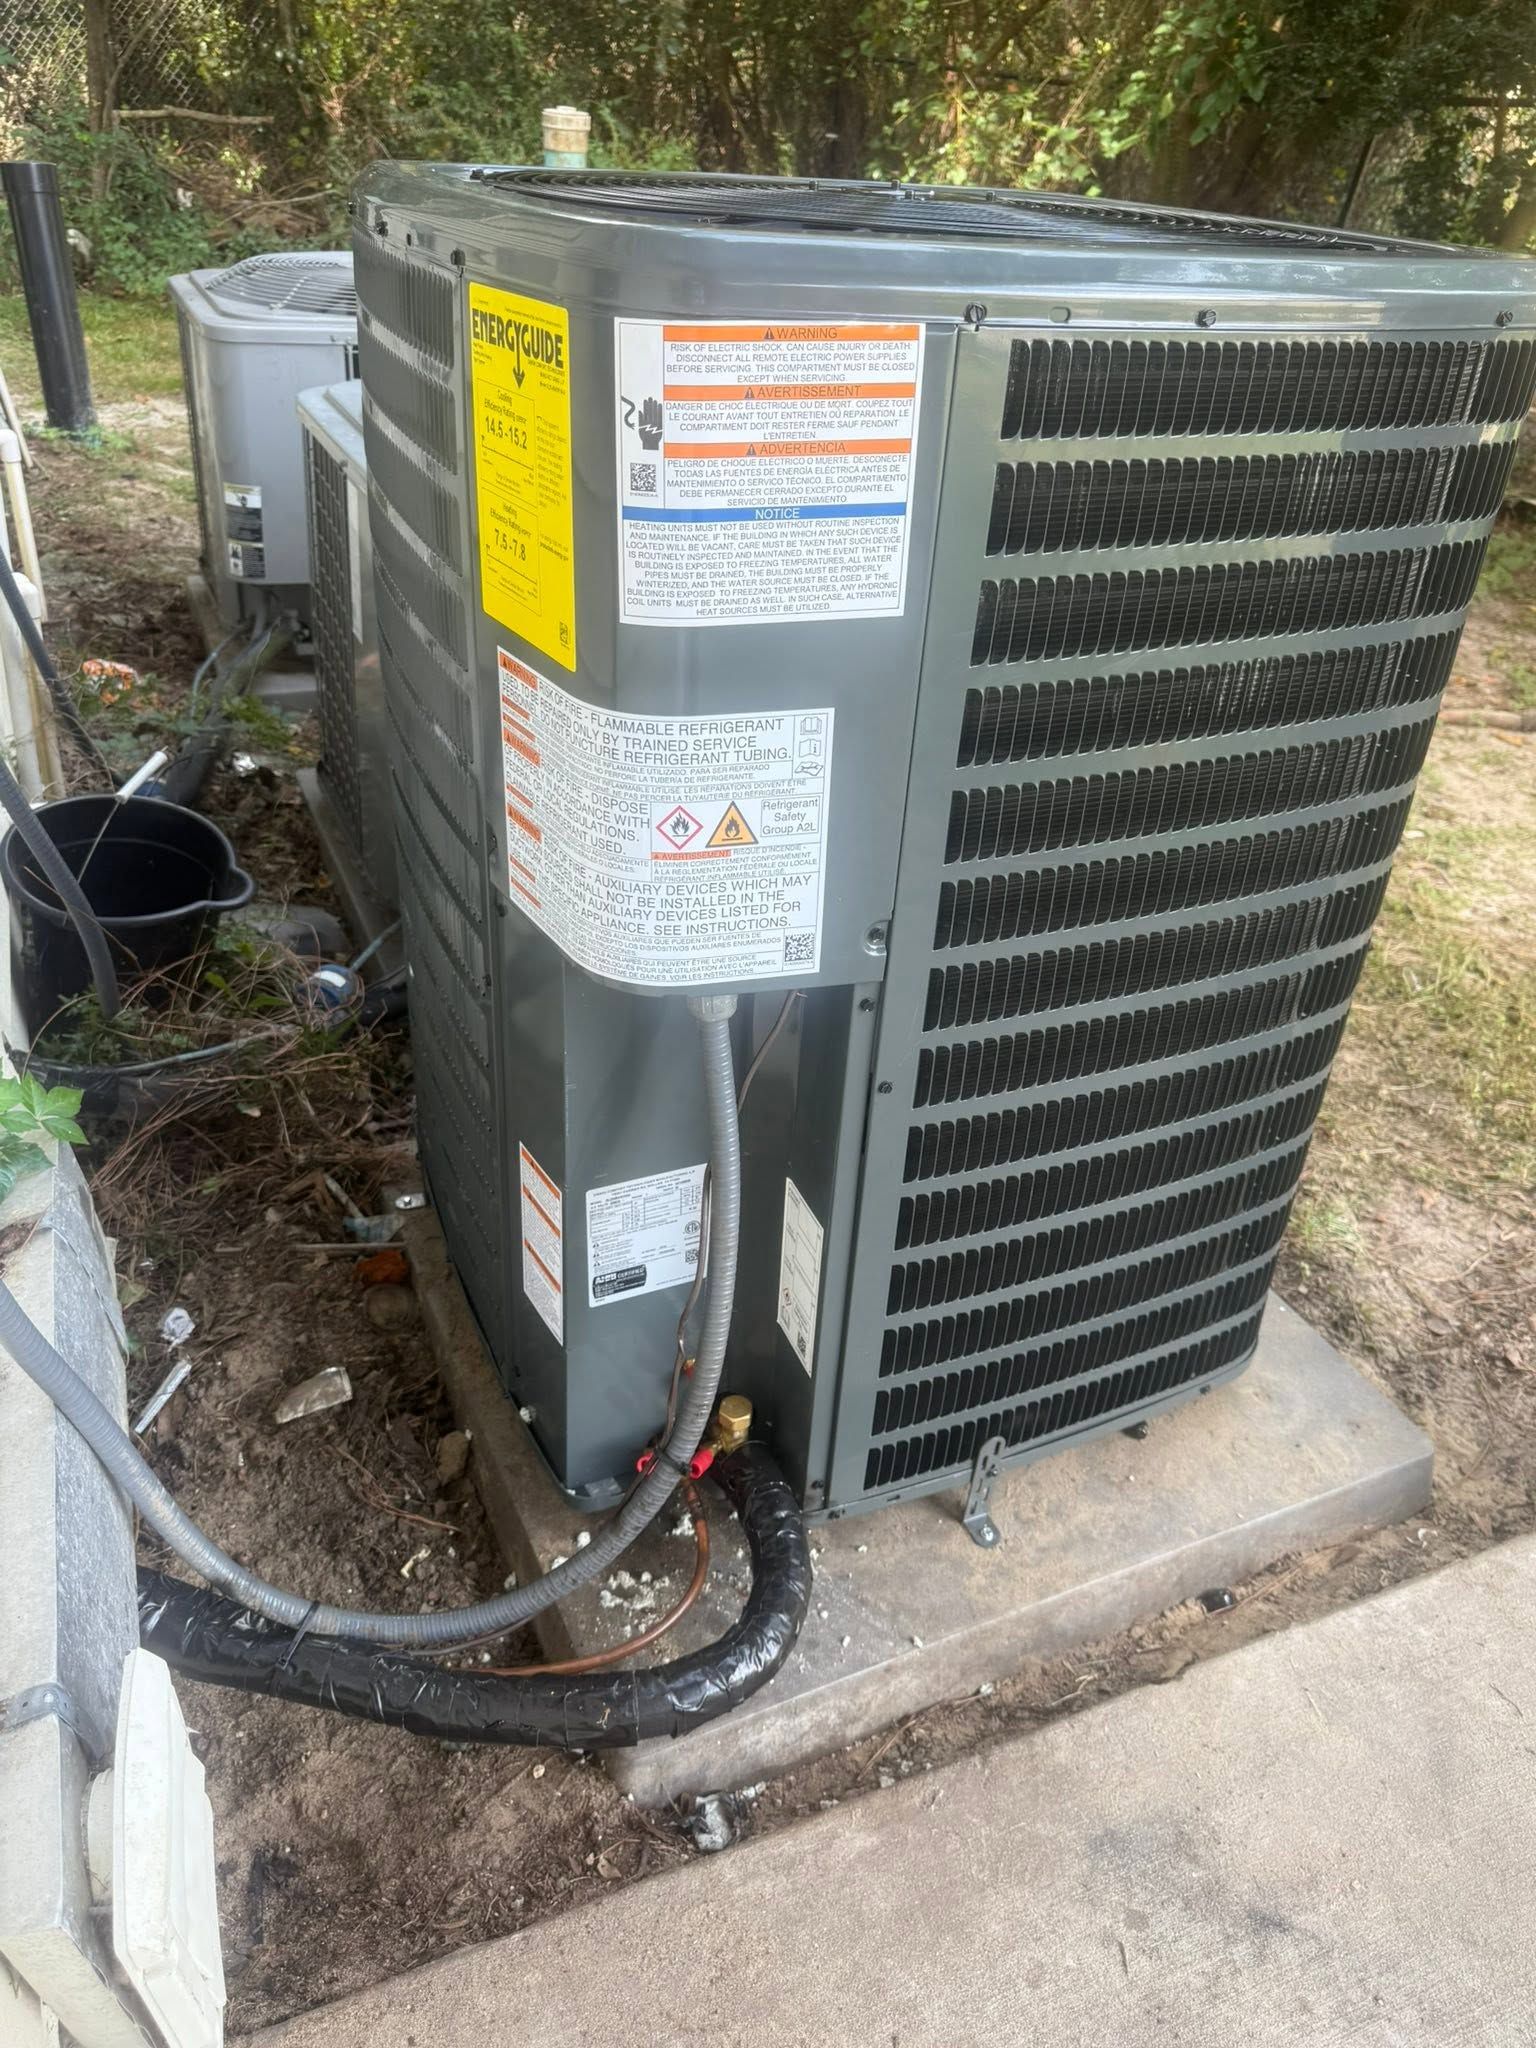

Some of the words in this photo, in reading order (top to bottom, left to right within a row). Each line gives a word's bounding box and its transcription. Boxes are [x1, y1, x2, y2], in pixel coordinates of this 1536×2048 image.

[472, 308, 564, 369] ENERGYGUIDE
[777, 327, 838, 339] WARNING
[671, 344, 691, 352] RISK
[694, 344, 705, 352] OF
[787, 343, 804, 351] CAN
[807, 343, 834, 351] CAUSE
[837, 343, 865, 351] INJURY
[676, 354, 732, 362] DISCONNECT
[736, 354, 750, 362] ALL
[753, 354, 788, 362] REMOTE
[791, 353, 831, 361] ELECTRIC
[834, 353, 864, 361] POWER
[666, 365, 702, 373] BEFORE
[757, 364, 774, 372] THIS
[777, 364, 840, 372] COMPARTMENT
[844, 363, 868, 371] MUST
[869, 363, 879, 371] BE
[882, 363, 914, 371] CLOSED
[738, 375, 770, 383] EXCEPT
[773, 374, 798, 382] WHEN
[758, 385, 861, 398] AVERTISSEMENT
[666, 403, 702, 411] DANGER
[705, 403, 716, 411] DE
[800, 401, 812, 409] OU
[856, 400, 889, 408] COUPEZ
[669, 413, 679, 421] LE
[682, 413, 724, 421] COURANT
[726, 412, 753, 420] AVANT
[756, 412, 778, 420] TOUT
[781, 411, 826, 419] ENTRETIEN
[680, 422, 747, 431] COMPARTIMENT
[750, 422, 769, 431] DOIT
[772, 421, 804, 430] RESTER
[837, 420, 859, 428] SAUF
[861, 419, 898, 427] PENDANT
[760, 442, 846, 455] ADVERTENCIA
[668, 460, 705, 468] PELIGRO
[707, 459, 718, 467] DE
[721, 459, 756, 467] CHOQUE
[853, 455, 907, 463] DESCONECTE
[675, 470, 703, 478] TODAS
[723, 468, 760, 477] FUENTES
[763, 468, 774, 476] DE
[862, 465, 887, 473] ANTES
[666, 479, 736, 488] MANTENIMIENTO
[680, 489, 702, 497] DEBE
[705, 488, 761, 497] PERMANECER
[806, 485, 843, 494] EXCEPTO
[845, 484, 881, 492] DURANTE
[755, 508, 800, 519] NOTICE
[629, 522, 665, 532] HEATING
[668, 523, 692, 532] UNITS
[695, 524, 718, 532] MUST
[720, 523, 736, 531] NOT
[753, 522, 774, 530] USED
[777, 521, 813, 529] WITHOUT
[816, 519, 849, 528] ROUTINE
[852, 518, 899, 526] INSPECTION
[626, 542, 664, 551] LOCATED
[667, 543, 686, 551] WILL
[689, 543, 699, 551] BE
[787, 540, 797, 548] BE
[800, 539, 825, 547] TAKEN
[828, 538, 846, 546] THAT
[849, 537, 871, 545] SUCH
[873, 536, 901, 544] DEVICE
[638, 551, 685, 561] ROUTINELY
[687, 552, 733, 561] INSPECTED
[833, 547, 858, 555] EVENT
[635, 561, 673, 570] BUILDING
[686, 561, 724, 570] EXPOSED
[645, 571, 669, 579] PIPES
[671, 571, 693, 579] MUST
[696, 571, 706, 579] BE
[766, 568, 802, 577] BUILDING
[829, 566, 839, 574] BE
[841, 564, 882, 573] PROPERLY
[858, 582, 897, 590] HYDRONIC
[647, 599, 671, 607] UNITS
[676, 599, 698, 607] MUST
[713, 598, 748, 606] DRAINED
[798, 594, 819, 602] SUCH
[846, 591, 897, 600] ALTERNATIVE
[696, 608, 717, 616] HEAT
[720, 607, 757, 615] SOURCES
[760, 604, 781, 612] MUST
[565, 700, 582, 719] FIRE
[591, 712, 674, 736] FLAMMABLE
[679, 718, 784, 736] REFRIGERANT
[573, 721, 599, 740] ONLY
[603, 732, 619, 746] BY
[623, 736, 688, 752] TRAINED
[693, 736, 757, 751] SERVICE
[566, 729, 620, 760] PUNCTURE
[624, 750, 730, 766] REFRIGERANT
[734, 747, 791, 762] TUBING.
[592, 792, 648, 815] DISPOSE
[763, 798, 818, 811] Refrigerant
[564, 804, 640, 842] REGULATIONS.
[614, 813, 650, 829] WITH
[774, 812, 806, 823] Safety
[762, 825, 794, 835] Group
[797, 822, 817, 832] A2L
[591, 835, 626, 855] USED.
[662, 850, 730, 860] AVERTISSEMENT
[595, 874, 661, 895] AUXILIARY
[666, 881, 727, 896] DEVICES
[731, 877, 778, 891] WHICH
[783, 874, 812, 887] MAY
[574, 875, 603, 899] SHALL
[607, 891, 633, 906] NOT
[637, 896, 656, 908] BE
[660, 894, 736, 909] INSTALLED
[741, 892, 754, 904] IN
[758, 889, 785, 901] THE
[588, 897, 652, 920] AUXILIARY
[656, 908, 717, 921] DEVICES
[721, 904, 769, 918] LISTED
[773, 901, 801, 913] FOR
[581, 907, 649, 935] APPLIANCE.
[654, 924, 681, 936] SEE
[686, 916, 791, 935] INSTRUCTIONS.
